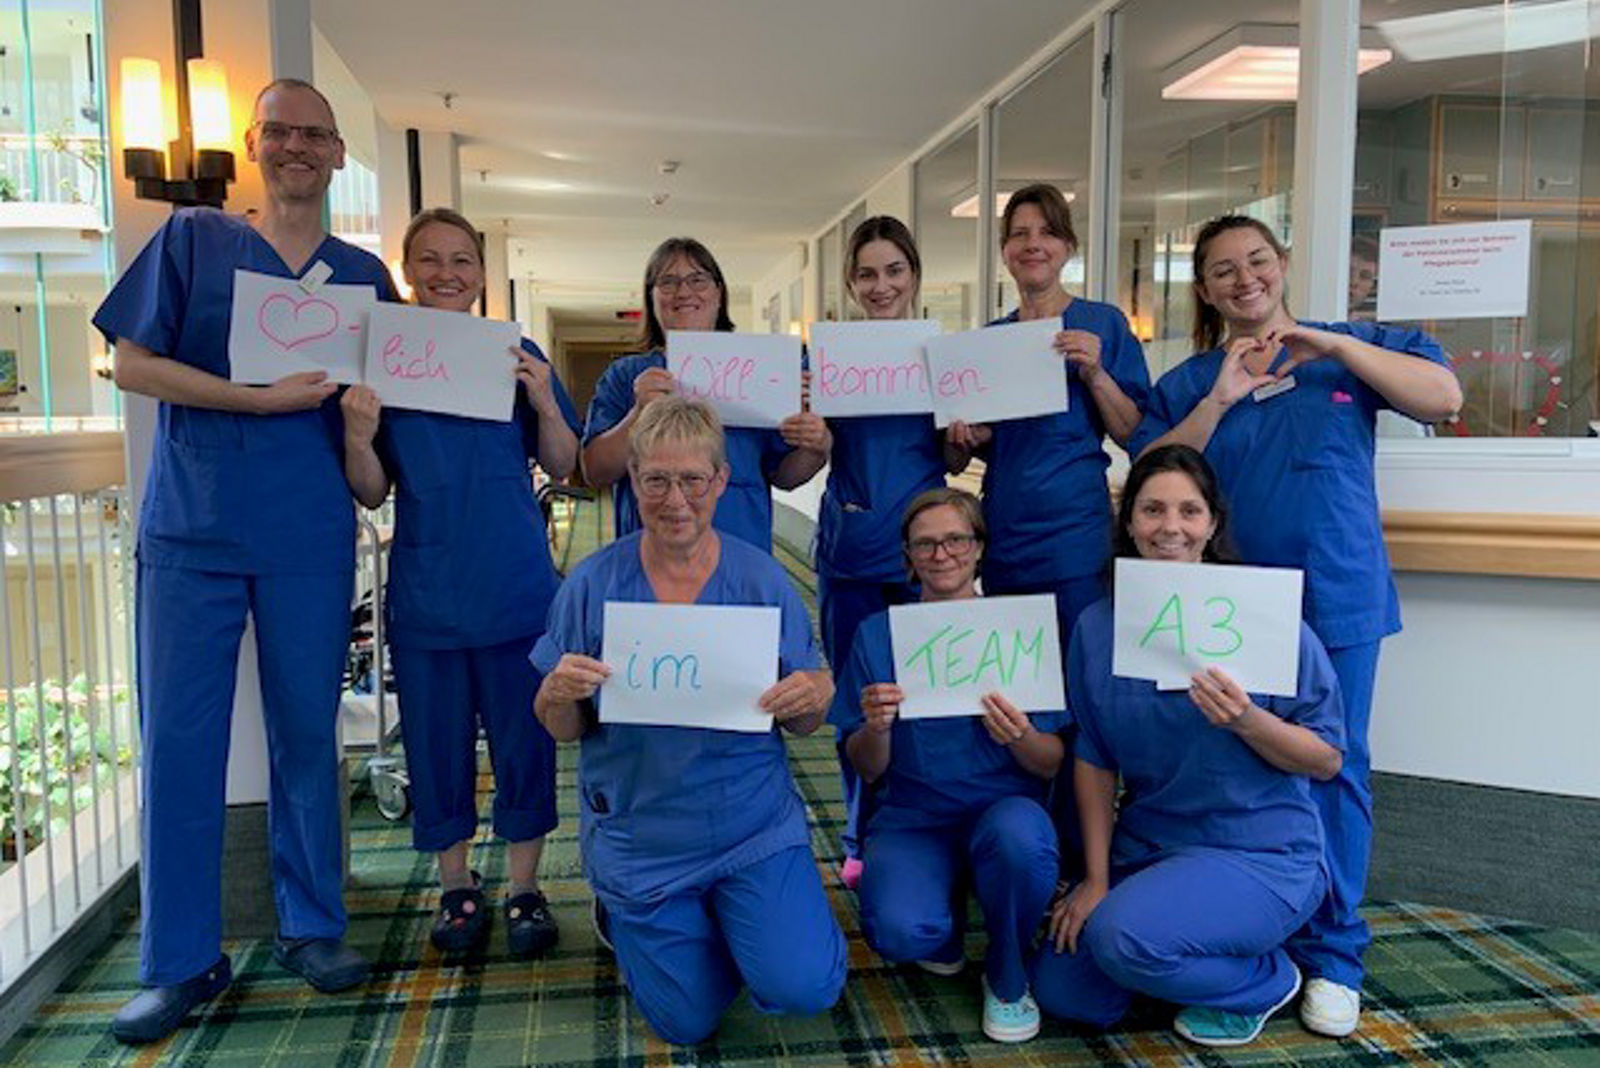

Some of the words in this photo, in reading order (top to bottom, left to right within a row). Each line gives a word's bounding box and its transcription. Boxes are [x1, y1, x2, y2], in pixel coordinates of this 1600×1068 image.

[381, 333, 449, 380] lich
[627, 640, 703, 691] im
[905, 624, 1045, 689] TEAM
